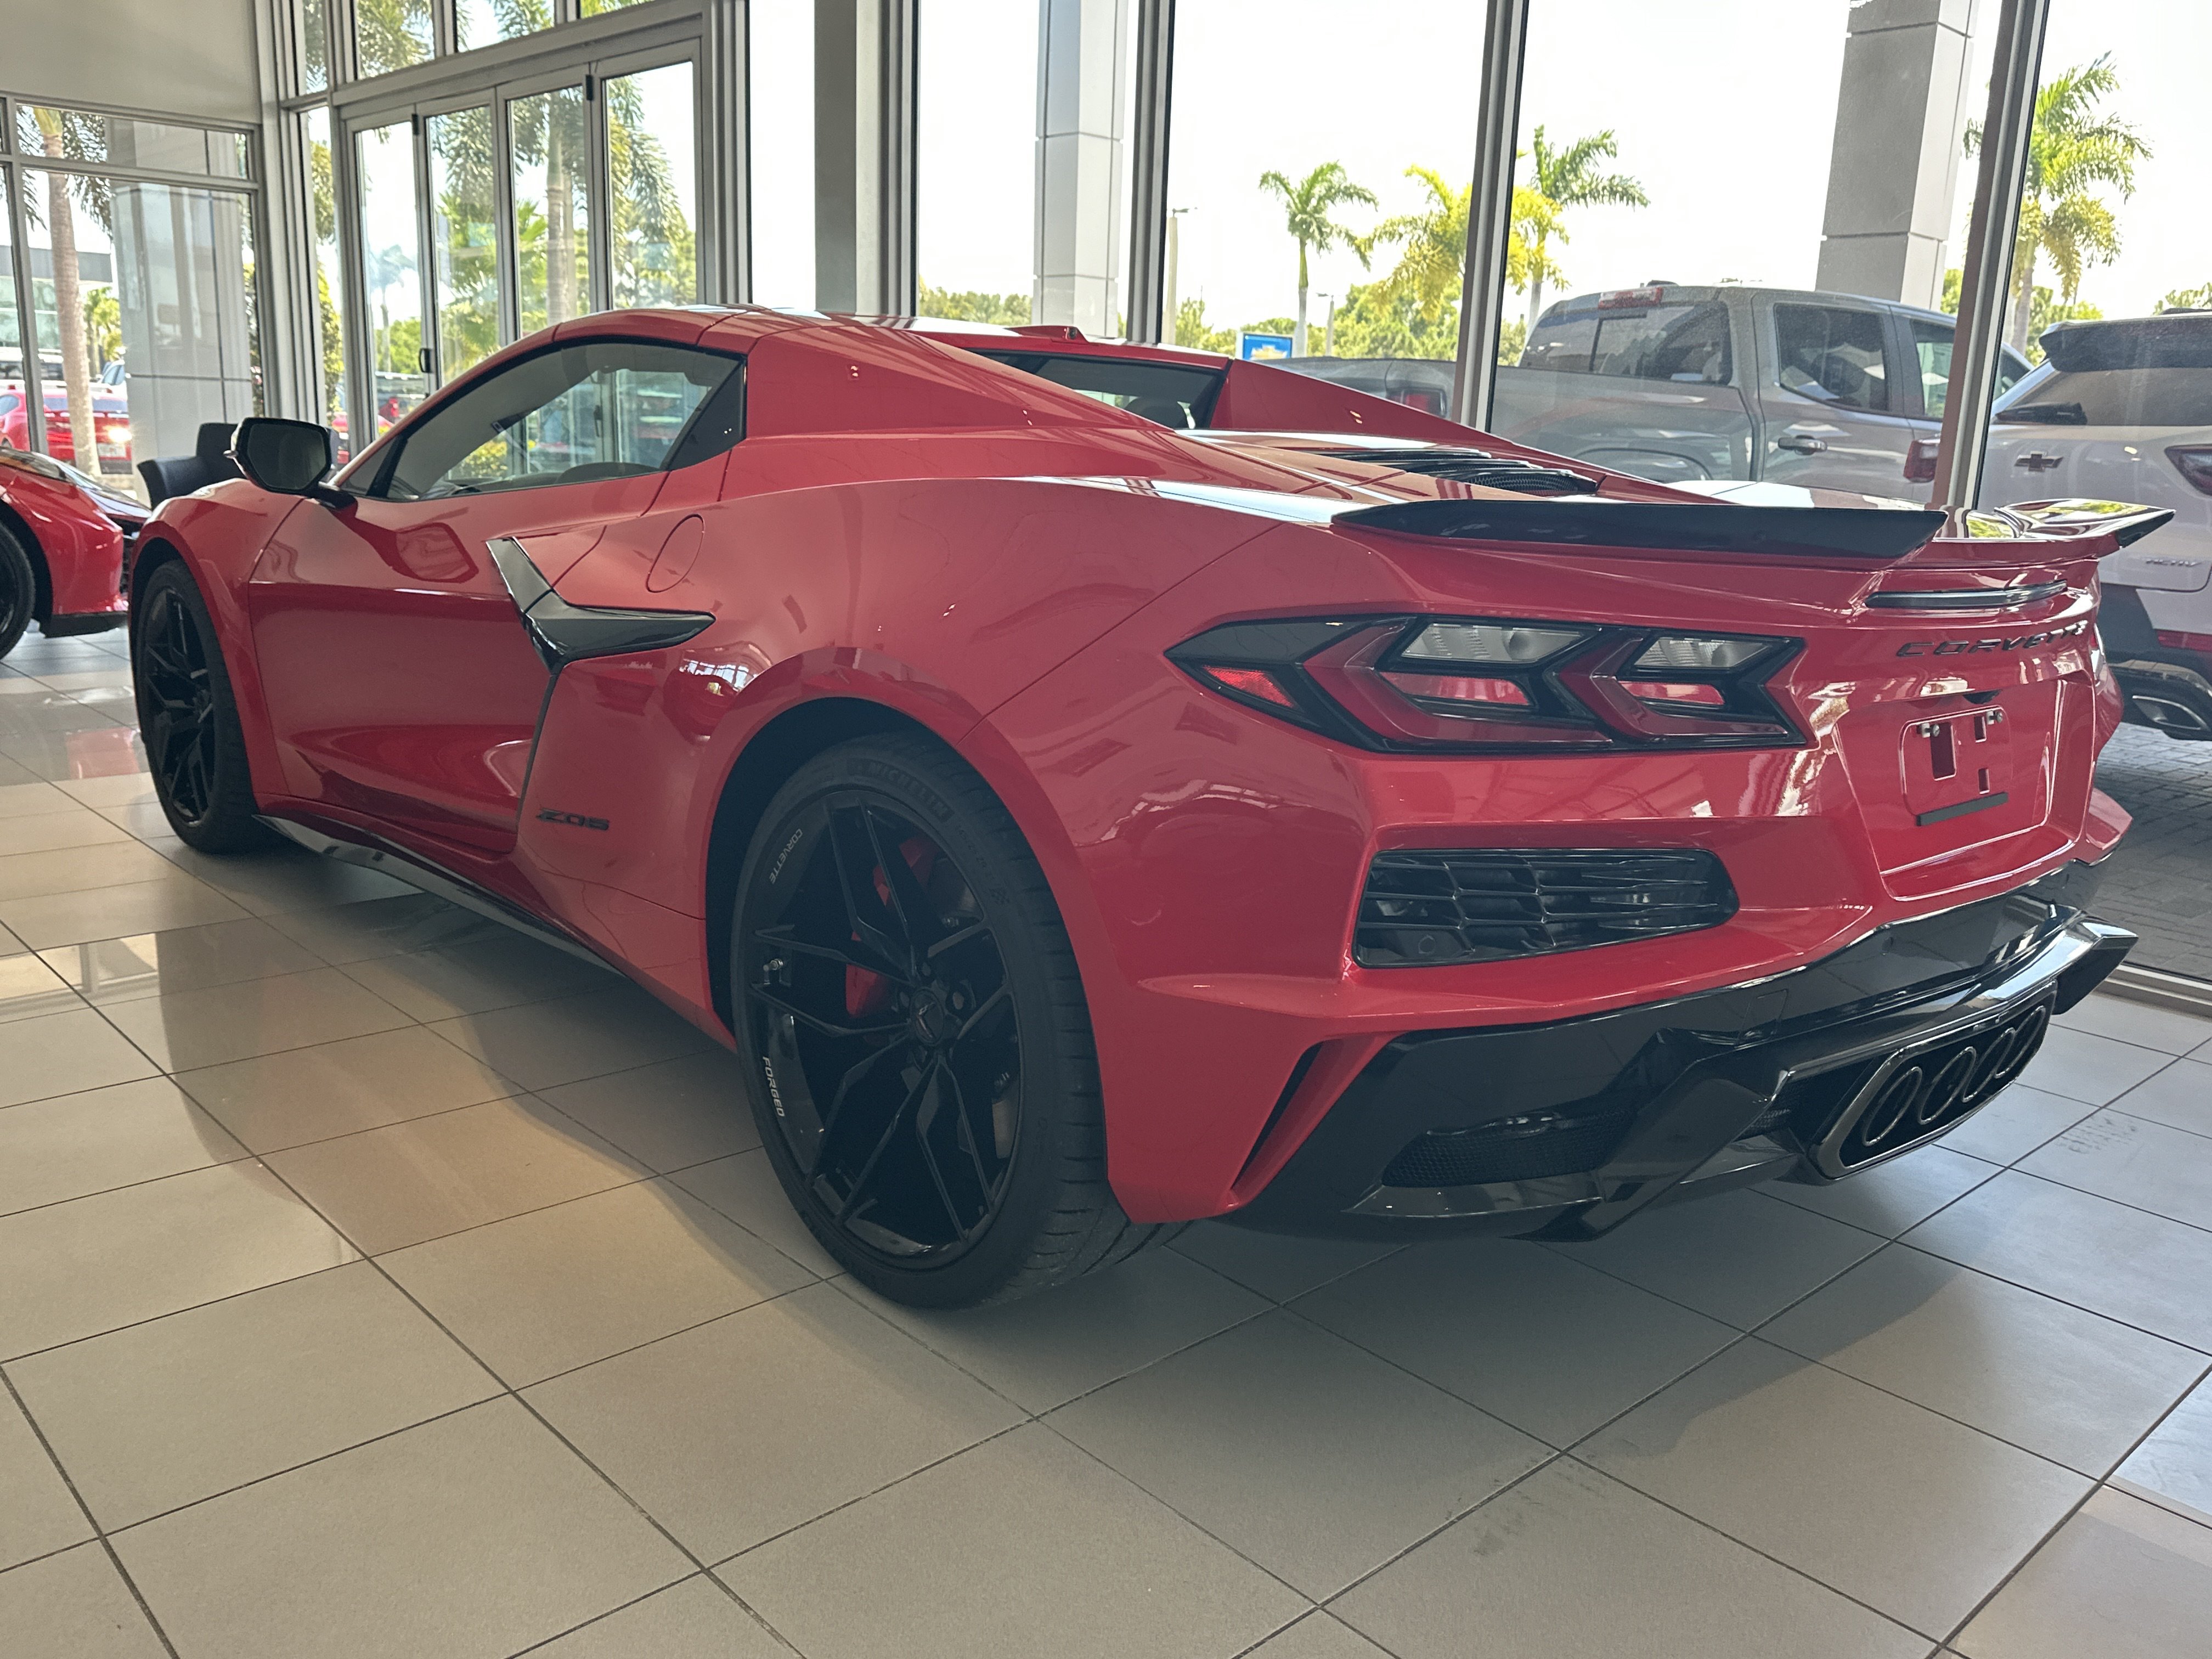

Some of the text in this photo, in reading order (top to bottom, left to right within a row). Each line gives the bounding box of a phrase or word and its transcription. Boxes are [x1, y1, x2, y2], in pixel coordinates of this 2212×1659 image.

[1895, 619, 2089, 658] CORVETTE
[769, 828, 803, 884] CORVETTE
[763, 1056, 785, 1116] FORGED
